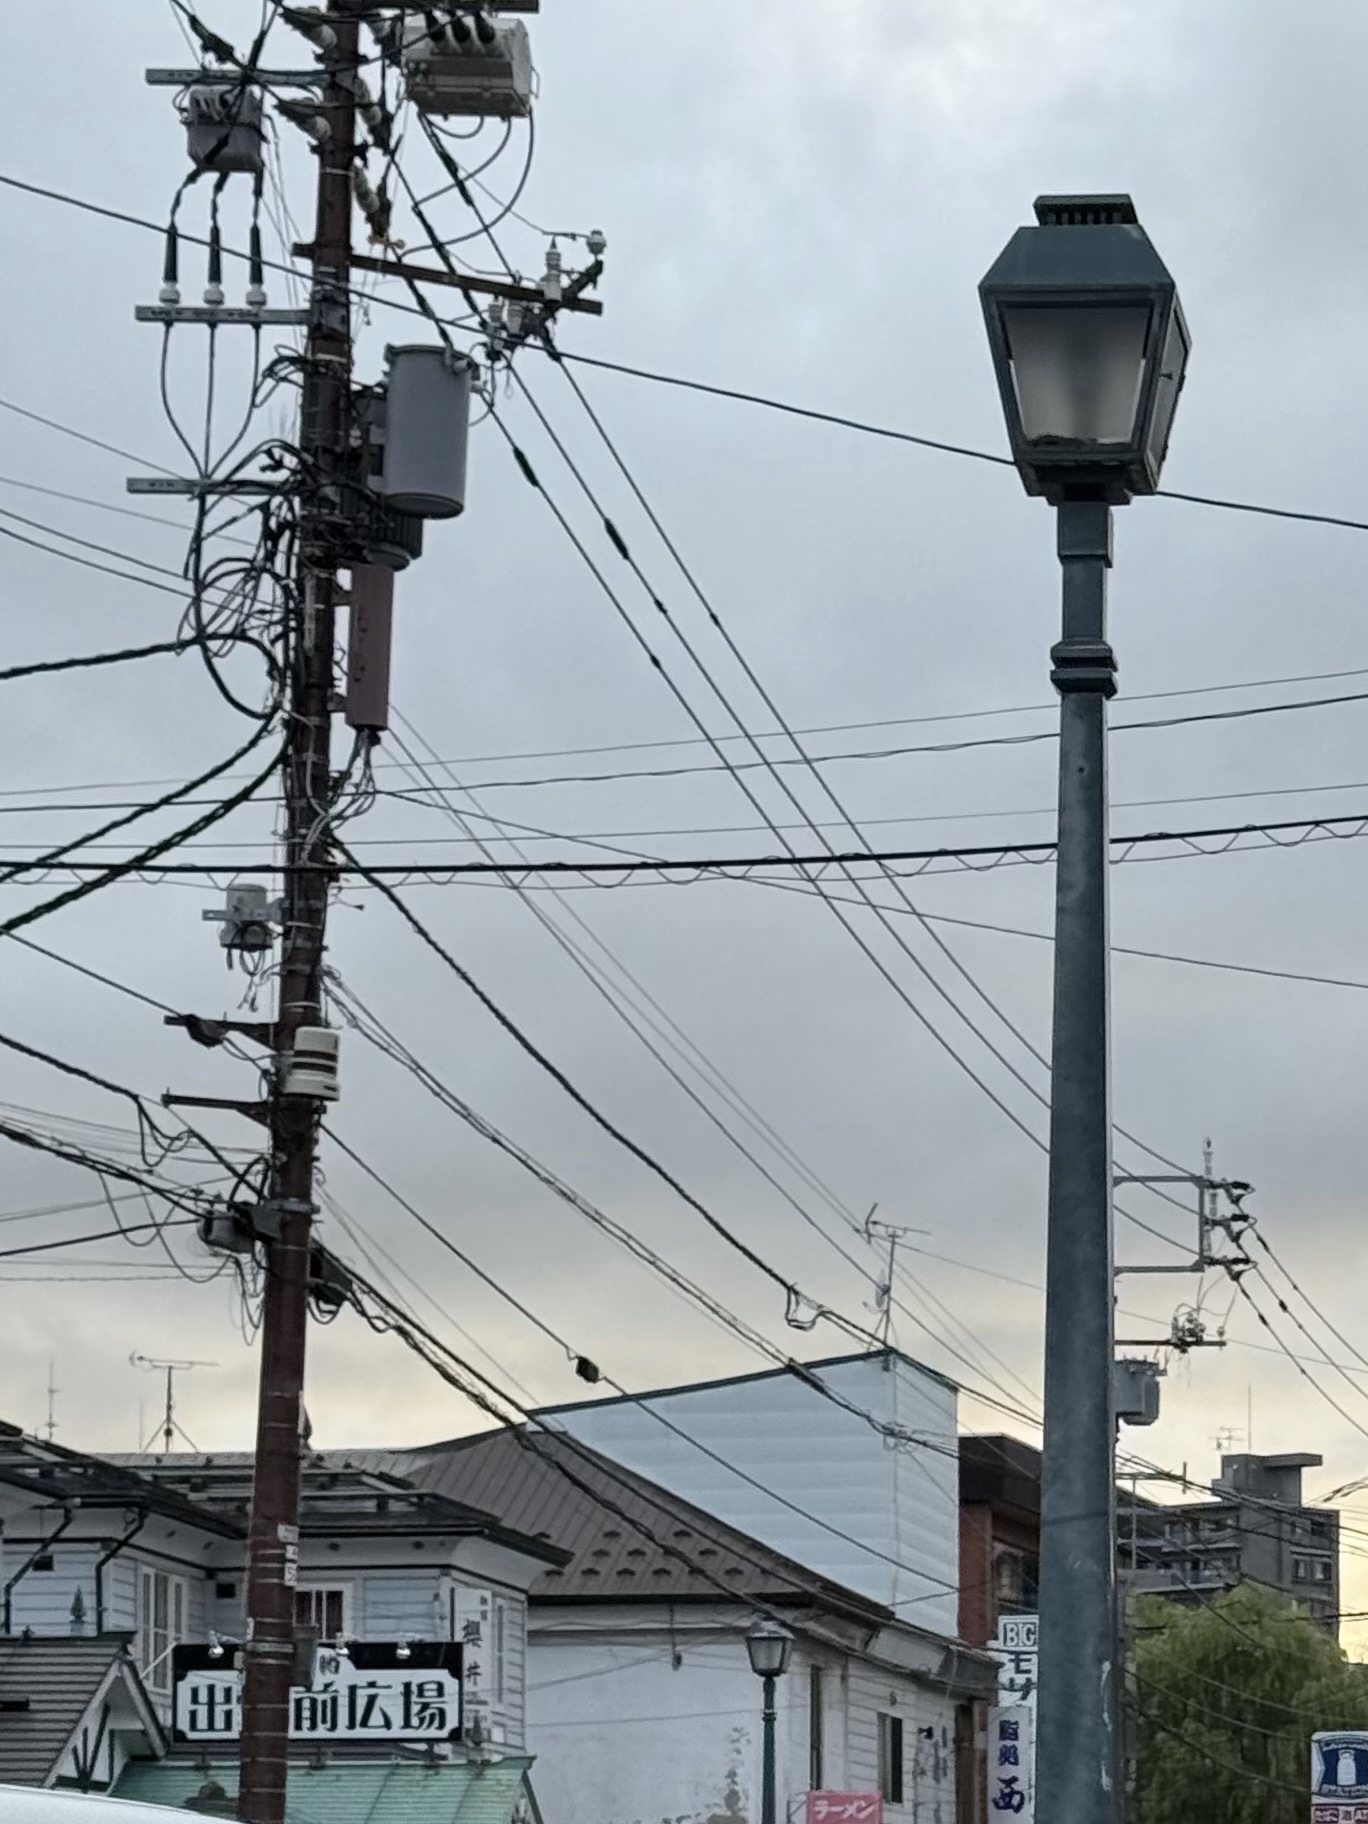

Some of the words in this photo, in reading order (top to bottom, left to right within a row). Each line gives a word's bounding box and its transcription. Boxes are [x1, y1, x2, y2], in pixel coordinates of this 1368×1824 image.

[1005, 1622, 1037, 1647] BIG
[188, 1680, 447, 1733] 出前広場
[814, 1799, 878, 1820] ラーメン
